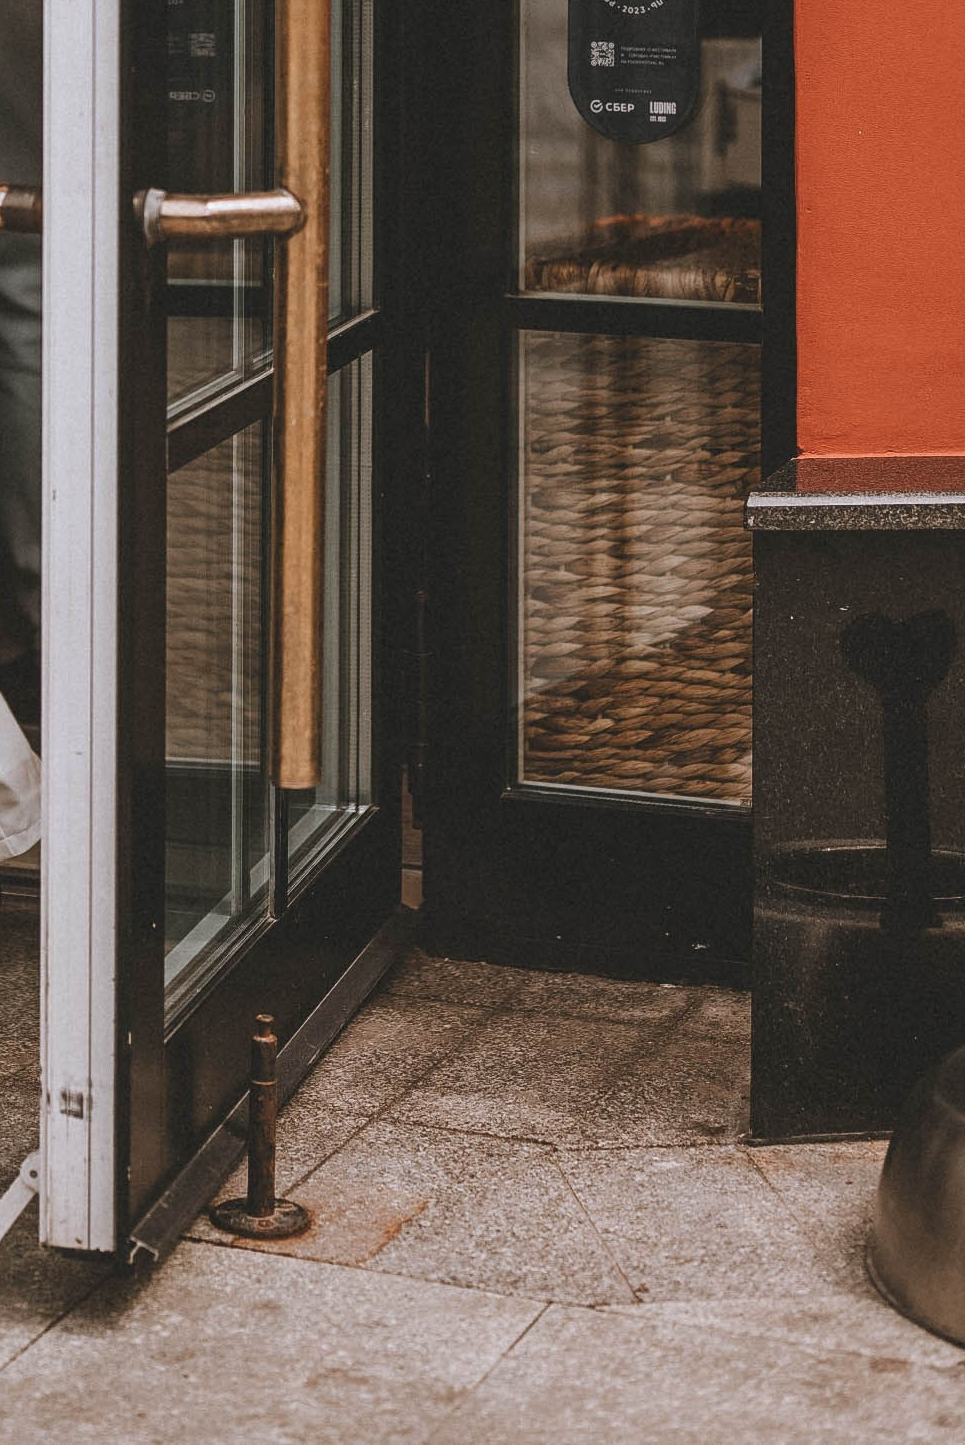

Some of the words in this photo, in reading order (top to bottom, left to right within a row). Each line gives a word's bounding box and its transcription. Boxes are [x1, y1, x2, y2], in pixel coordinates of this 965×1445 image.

[621, 4, 646, 15] 2023
[605, 102, 636, 113] СБЕР
[649, 100, 677, 115] LUDING
